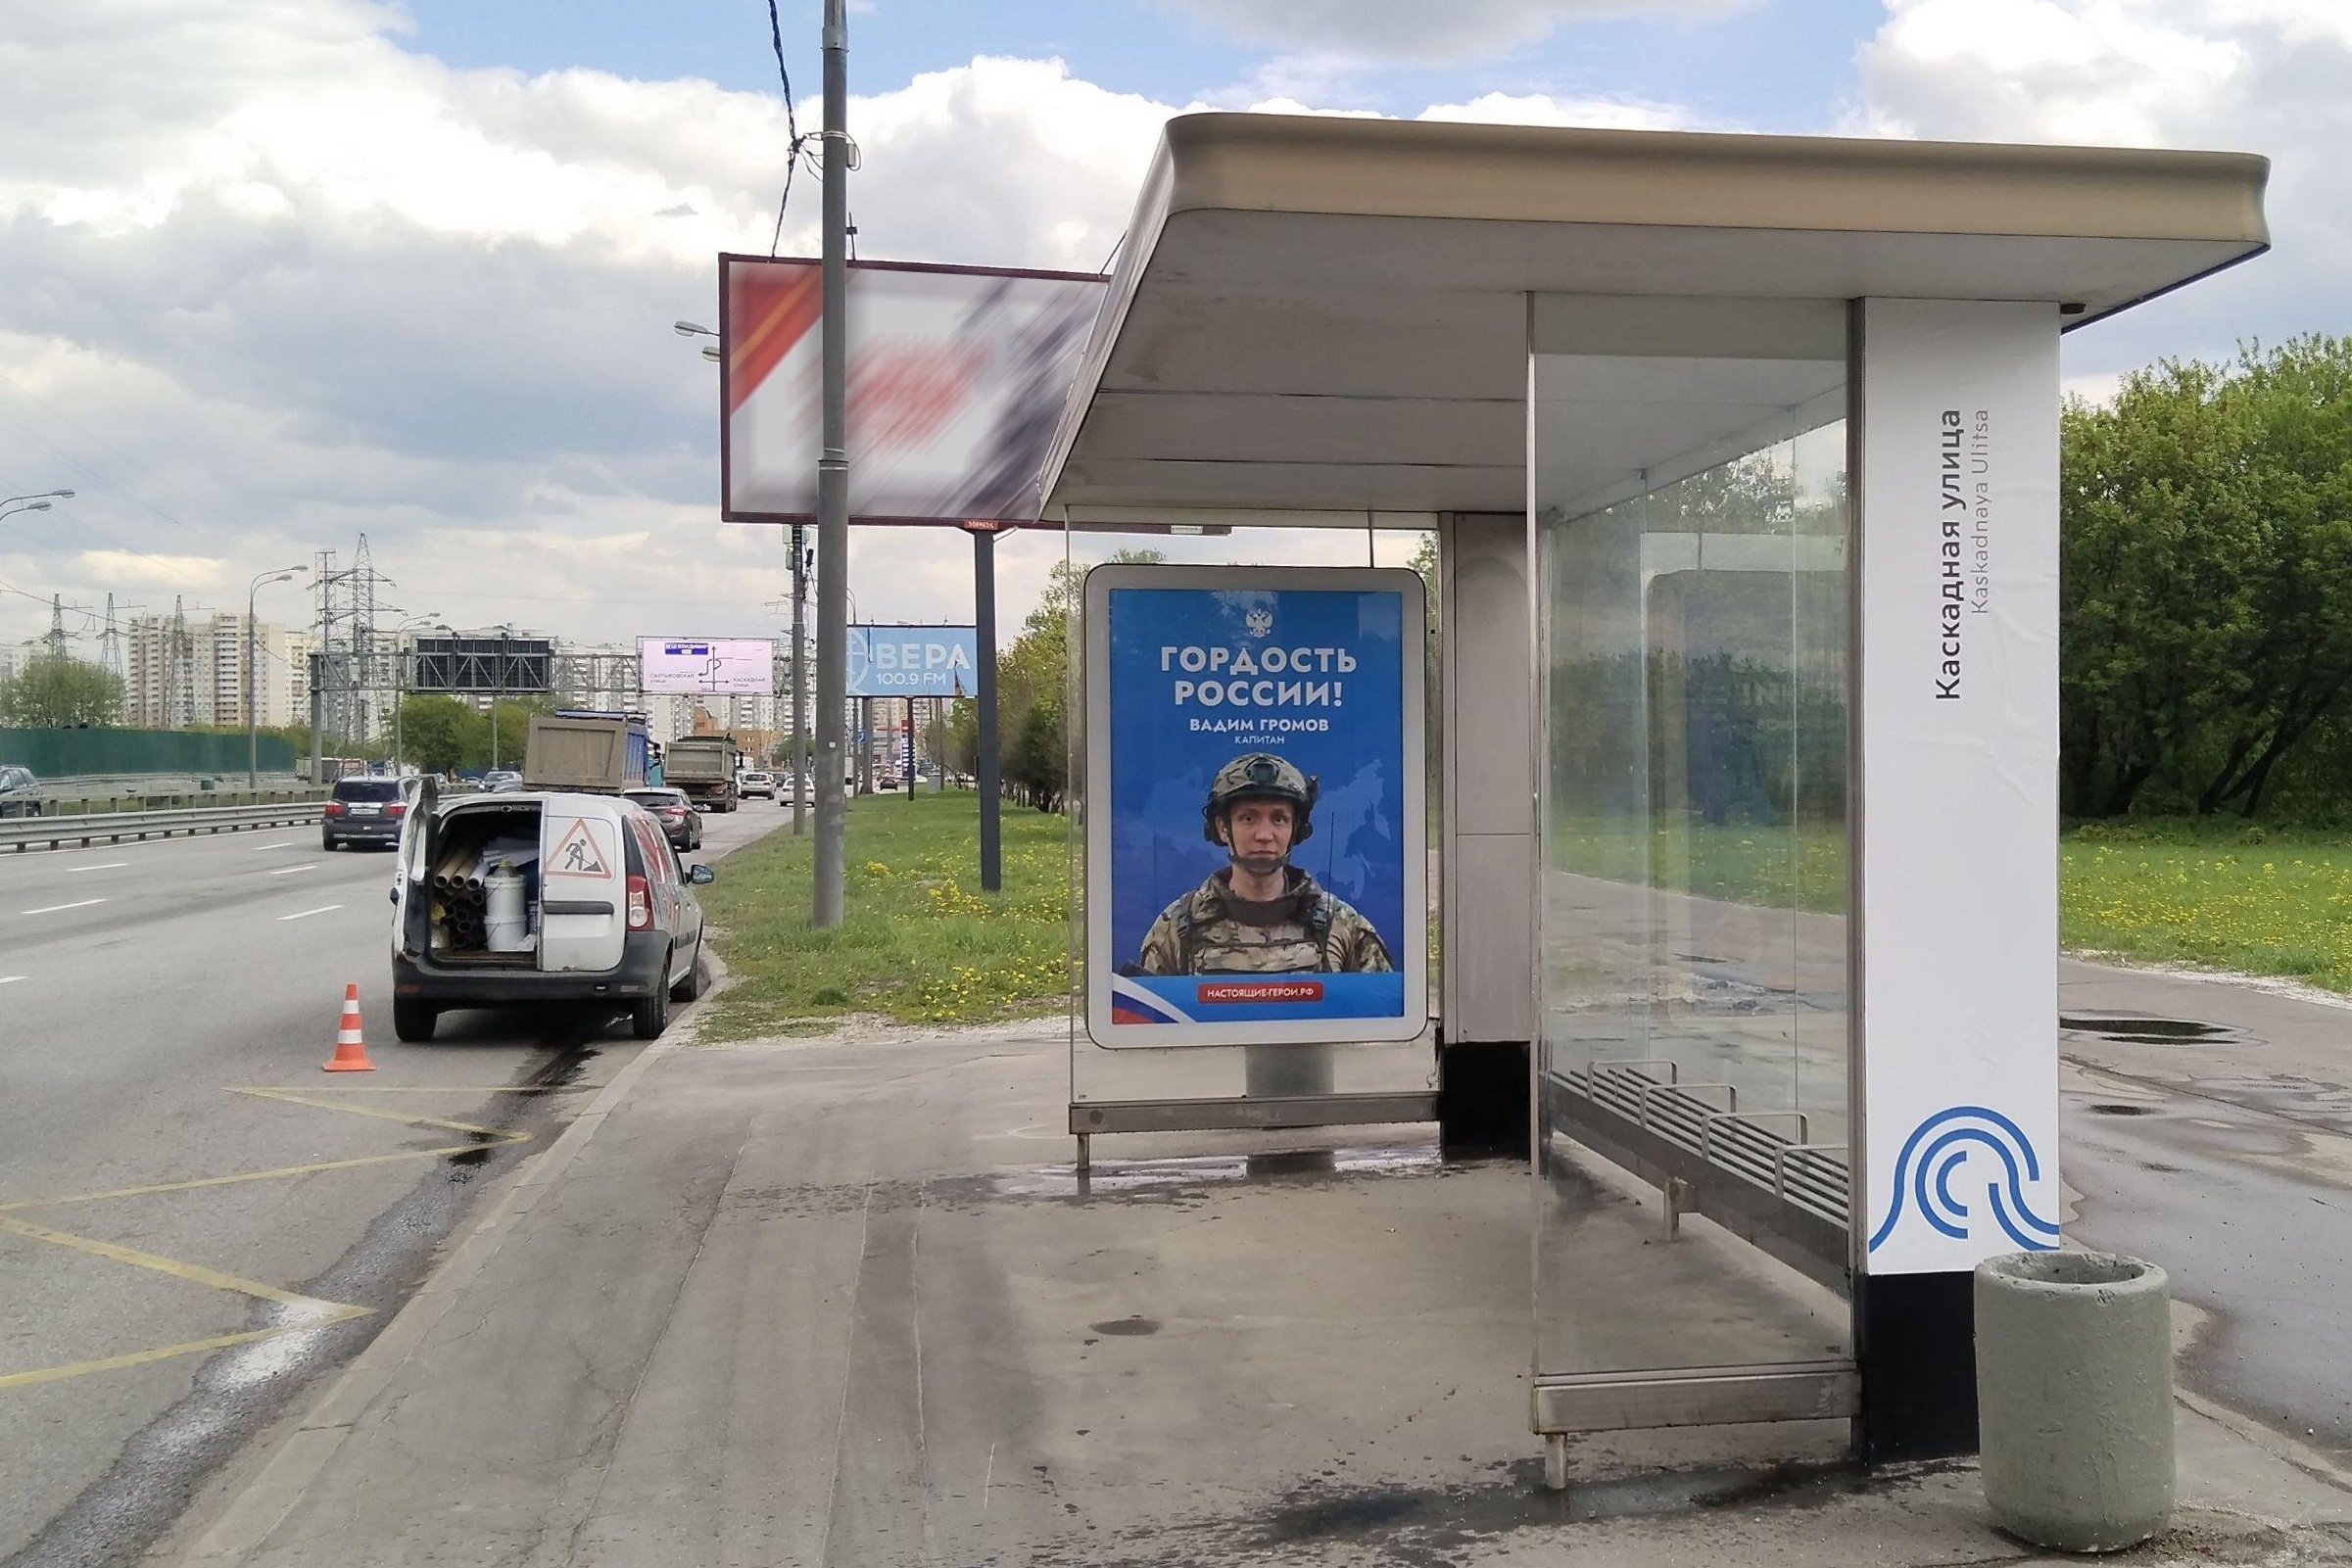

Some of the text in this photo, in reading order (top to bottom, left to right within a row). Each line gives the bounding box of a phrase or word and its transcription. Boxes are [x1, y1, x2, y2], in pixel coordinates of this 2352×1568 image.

[1970, 409, 1992, 614] Kaskadnaya Ulitsa
[1935, 409, 1966, 699] Каскадная улица
[876, 642, 971, 670] ВЕРА
[1161, 646, 1358, 676] ГОРДОСТЬ
[877, 672, 946, 686] 100.9 FM
[1175, 680, 1342, 707] РОССИИ!
[1189, 718, 1329, 734] ВАДИМ ГРОМОВ
[1234, 735, 1285, 745] КАПИТАН
[1206, 987, 1315, 998] НАСТОЯЩИЕ-ГЕРОИ.РФ
